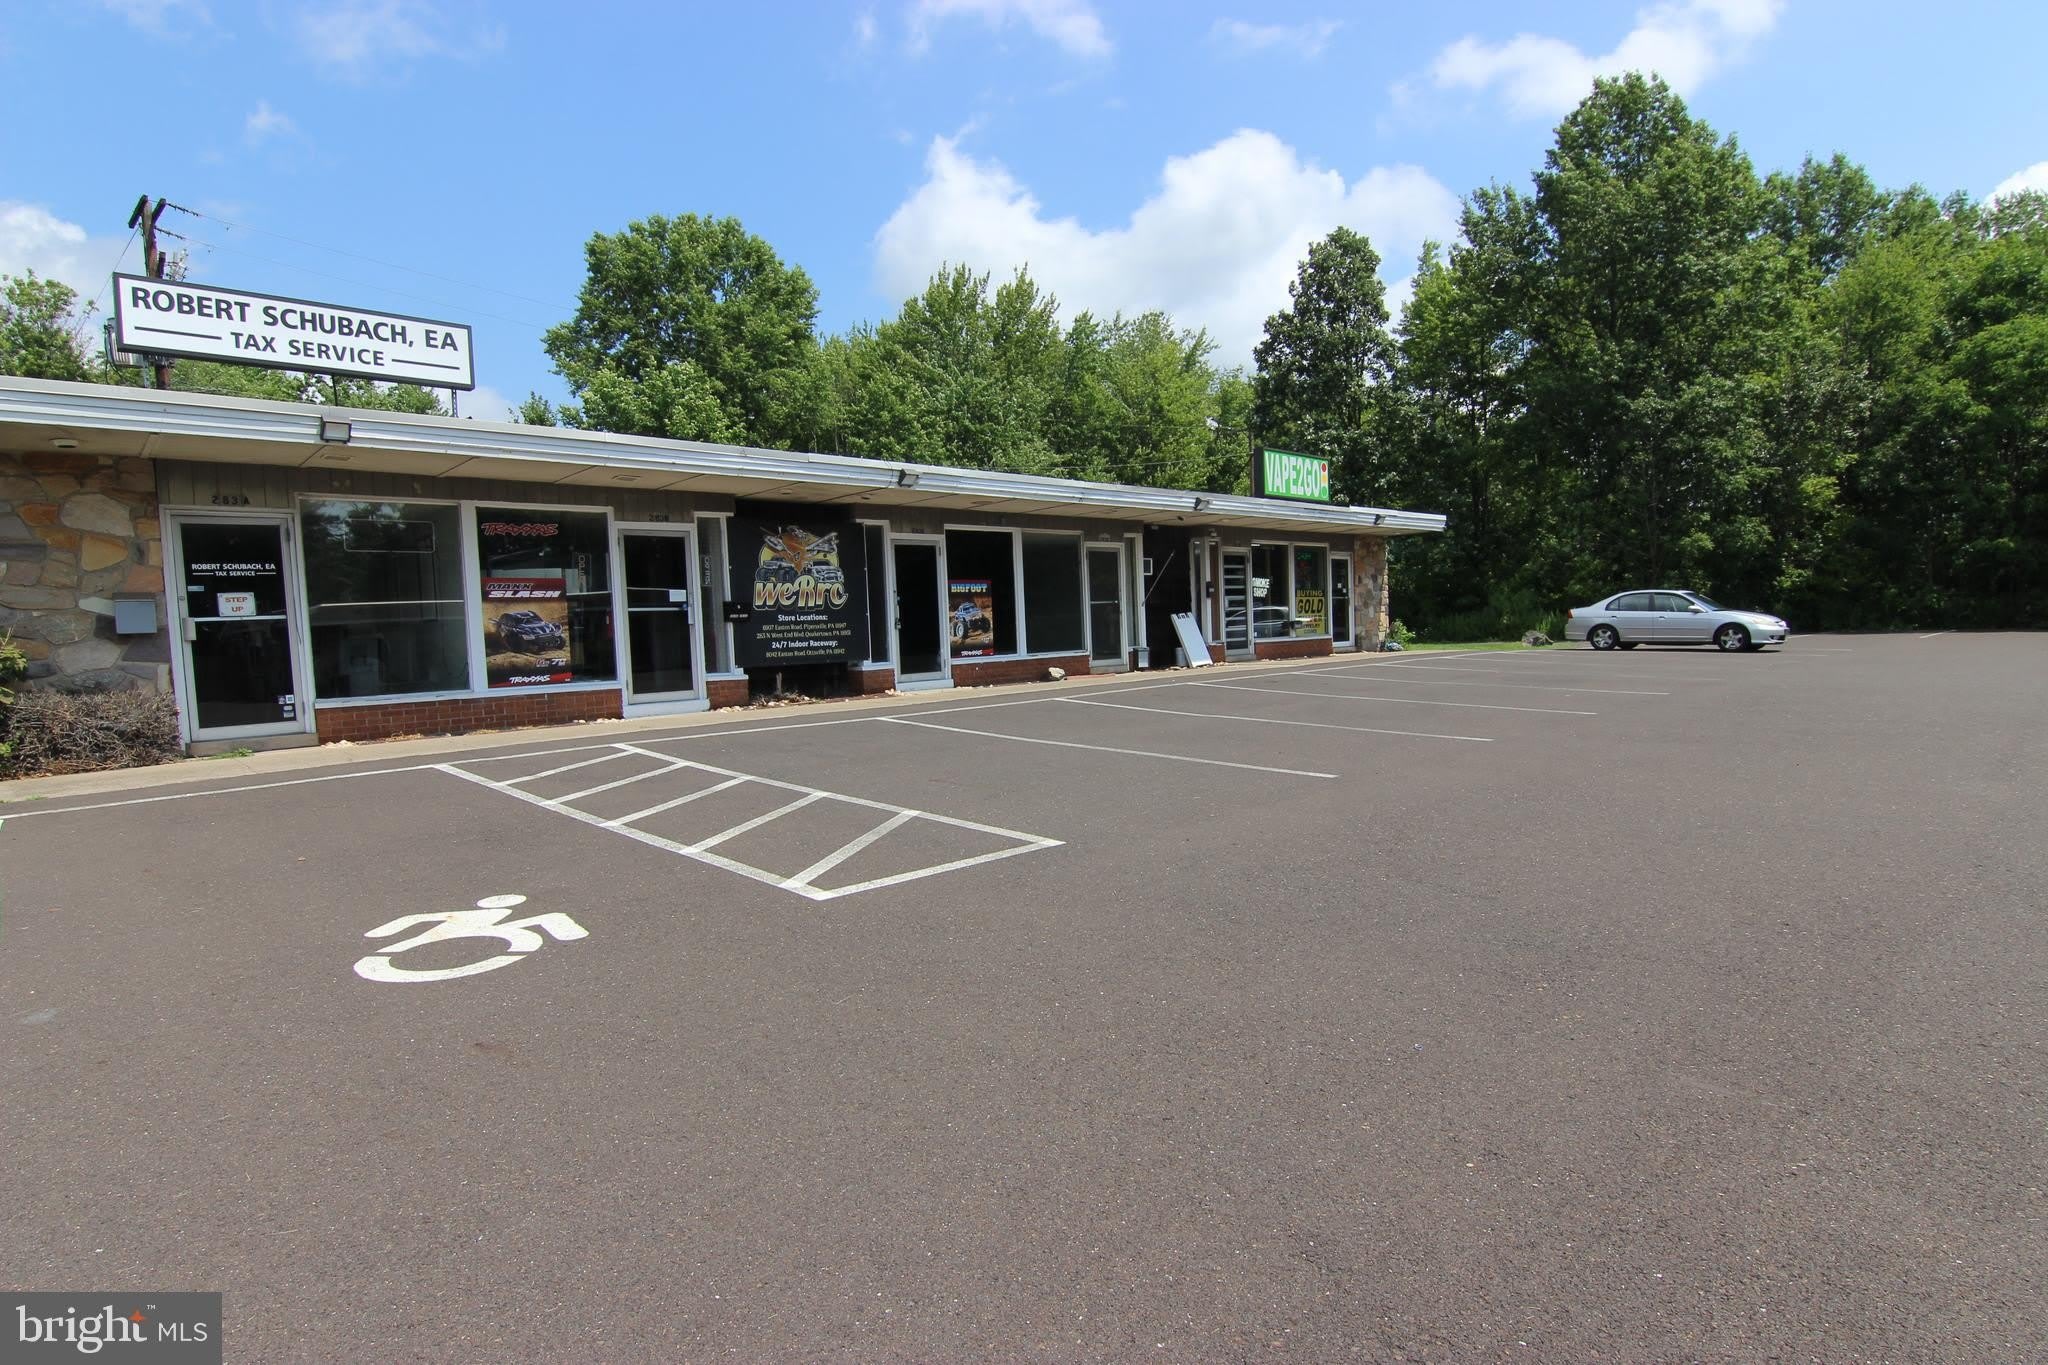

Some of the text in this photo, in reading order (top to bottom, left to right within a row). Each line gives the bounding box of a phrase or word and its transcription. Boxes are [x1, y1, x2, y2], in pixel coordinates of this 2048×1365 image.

[131, 286, 458, 351] ROBERT SCHUBACH, EA
[230, 331, 385, 366] TAX SERVICE
[1264, 451, 1320, 498] VAPE2GO
[211, 495, 251, 505] 283A
[481, 522, 559, 536] TRAXXAS
[222, 563, 263, 571] SCHUBACH,
[487, 583, 533, 591] MAXX
[951, 583, 988, 593] BIGFOOT
[488, 590, 561, 598] SLASH
[1253, 588, 1267, 598] SHOP
[1296, 589, 1323, 597] BUYING
[1297, 598, 1323, 614] GOLD
[778, 613, 829, 622] Store Locations:
[772, 640, 838, 648] 24/7 Indoor Raceway:
[509, 674, 551, 684] TRAXXAS
